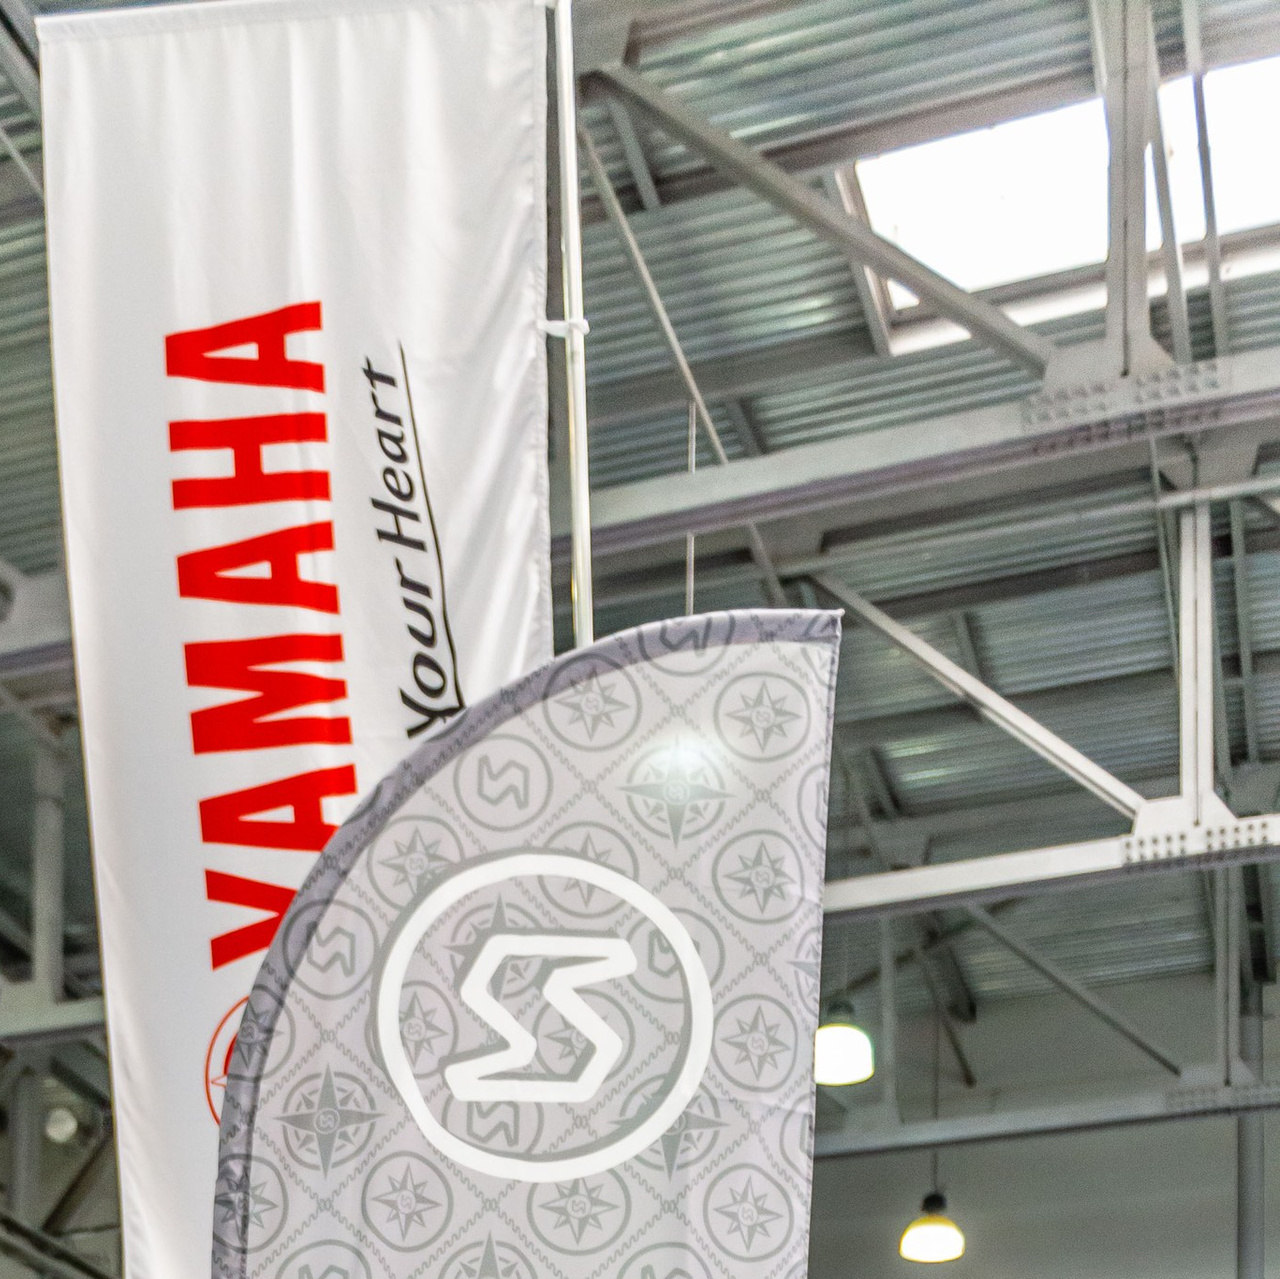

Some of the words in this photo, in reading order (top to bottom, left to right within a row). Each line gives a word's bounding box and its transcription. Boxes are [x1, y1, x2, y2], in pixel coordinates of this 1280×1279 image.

[361, 355, 428, 553] Heart
[165, 301, 358, 970] YAMAHA
[396, 556, 464, 738] Your
